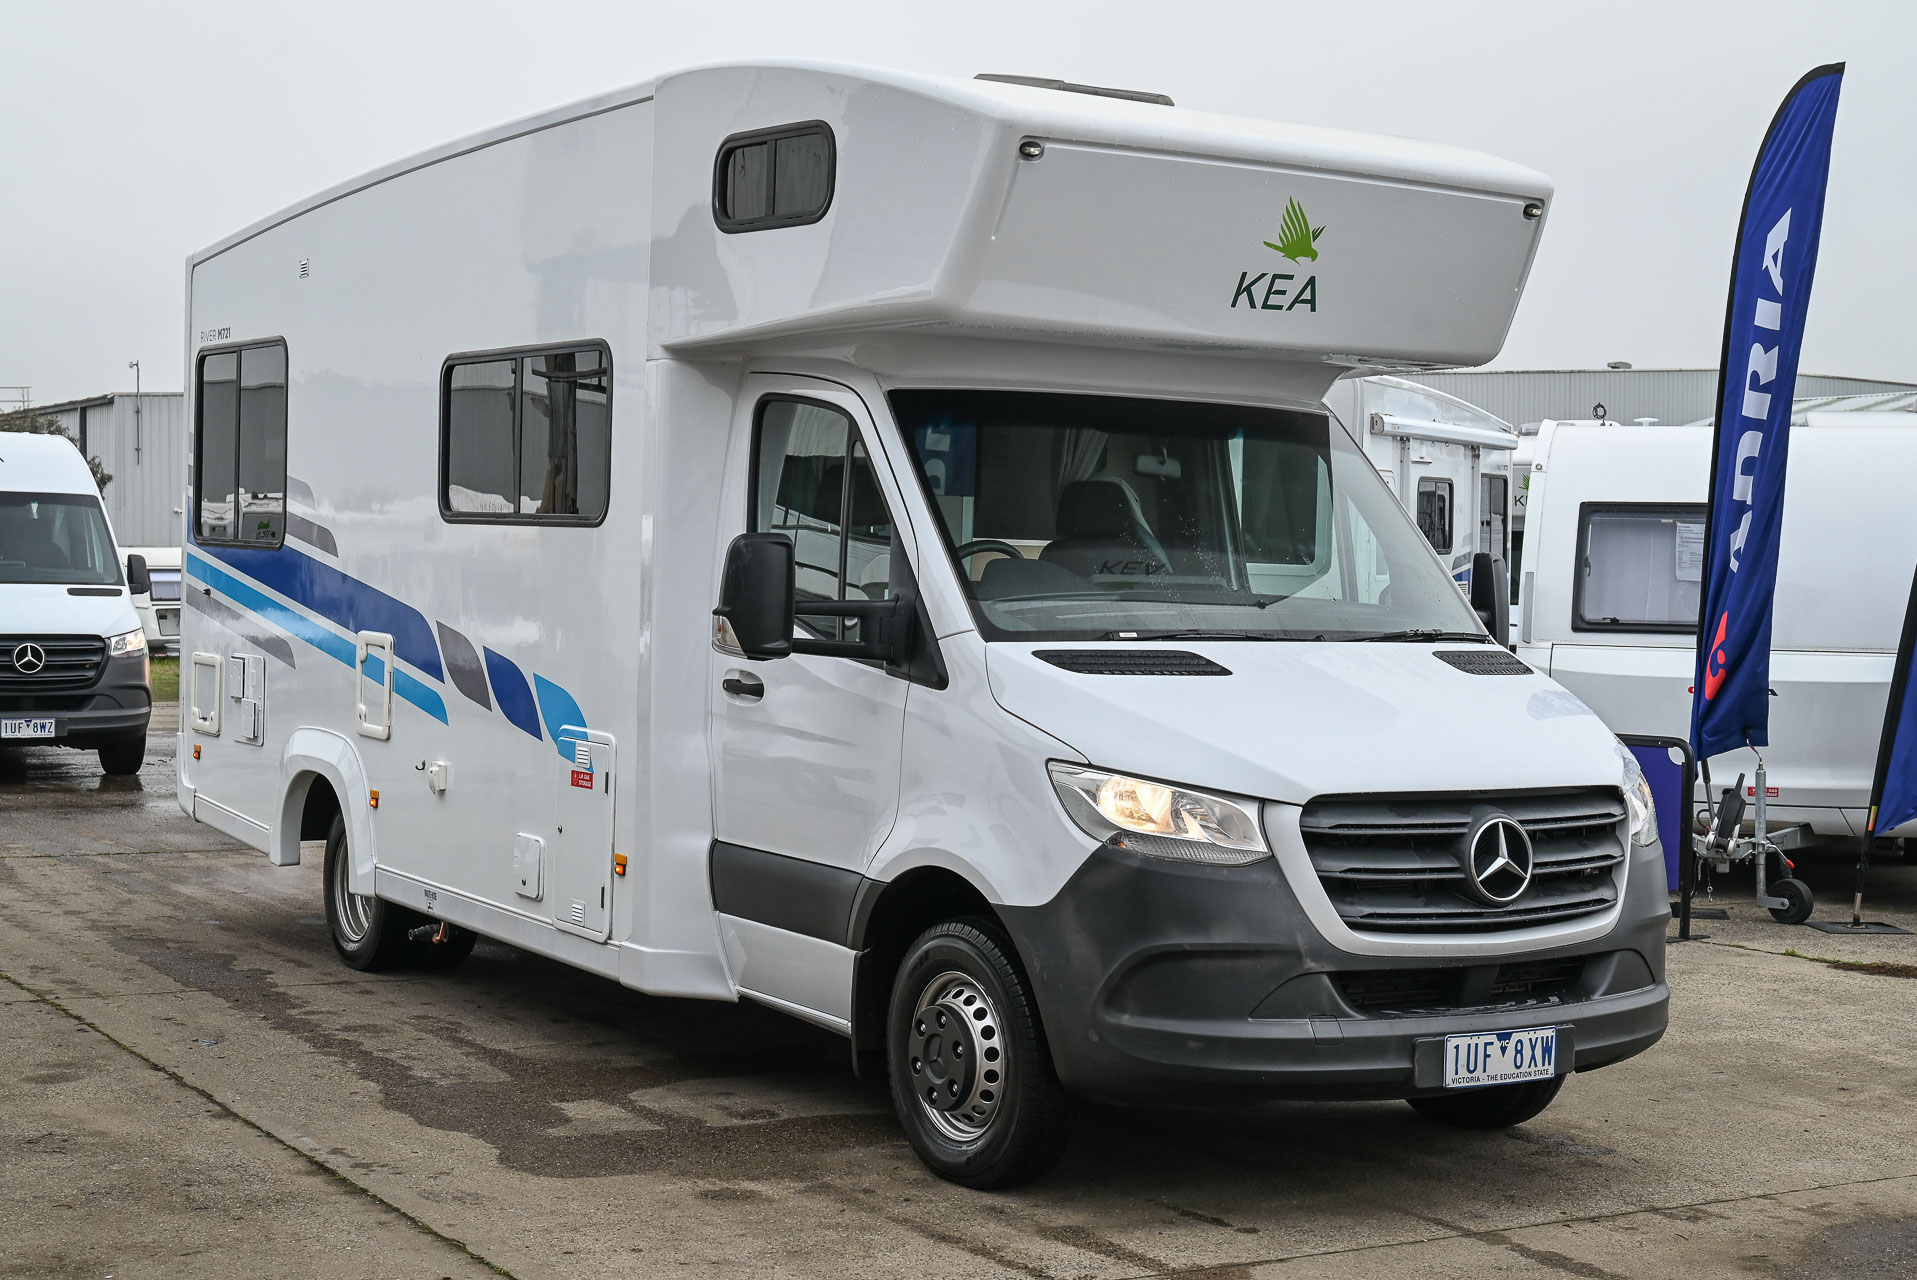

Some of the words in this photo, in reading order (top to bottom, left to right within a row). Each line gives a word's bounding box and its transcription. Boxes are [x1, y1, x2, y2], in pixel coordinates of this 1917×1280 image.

[1231, 271, 1317, 312] KEA
[217, 326, 231, 340] M721
[4, 722, 24, 734] 1UF
[32, 722, 53, 733] 8WZ
[1453, 1041, 1495, 1076] 1UF
[1513, 1035, 1554, 1069] 8XW
[1451, 1075, 1481, 1085] VICTORIA
[1486, 1074, 1499, 1082] THE
[1500, 1070, 1532, 1080] EDUCATION
[1533, 1068, 1550, 1077] STATE
